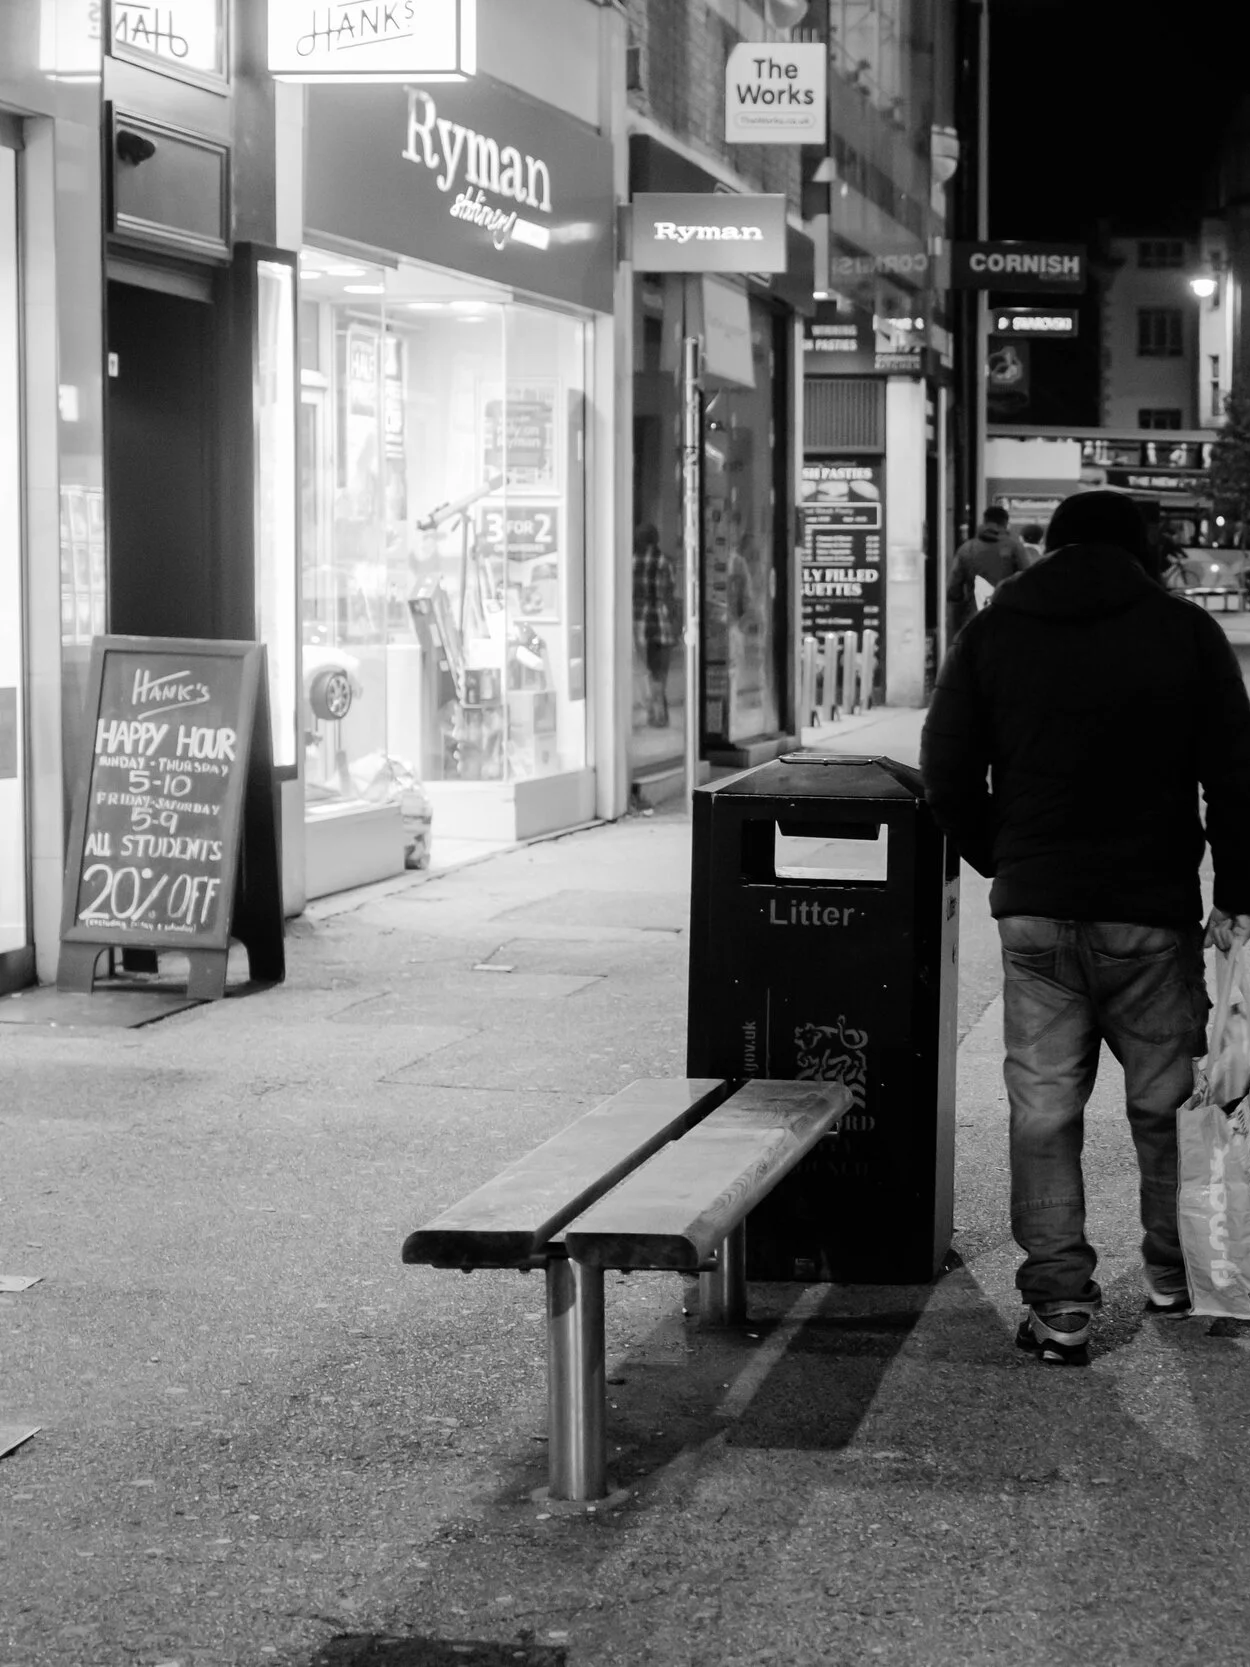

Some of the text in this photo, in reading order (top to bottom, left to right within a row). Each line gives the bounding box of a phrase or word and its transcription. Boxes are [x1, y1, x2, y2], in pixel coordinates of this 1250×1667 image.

[752, 57, 799, 80] The
[736, 83, 815, 105] Works
[402, 84, 553, 213] Ryman
[652, 221, 764, 245] Ryman
[969, 252, 1081, 274] CORNISH
[821, 467, 874, 480] PASTIES
[486, 512, 553, 544] 3 FOR 2
[825, 568, 879, 582] FILLED
[95, 718, 237, 761] HAPPY HOUR
[98, 755, 146, 770] SUNDAY
[157, 757, 229, 777] THURSDAY
[130, 806, 180, 835] 5-9
[85, 832, 223, 862] ALL STUDENTS
[79, 863, 221, 925] 20% OFF
[769, 899, 855, 927] Litter
